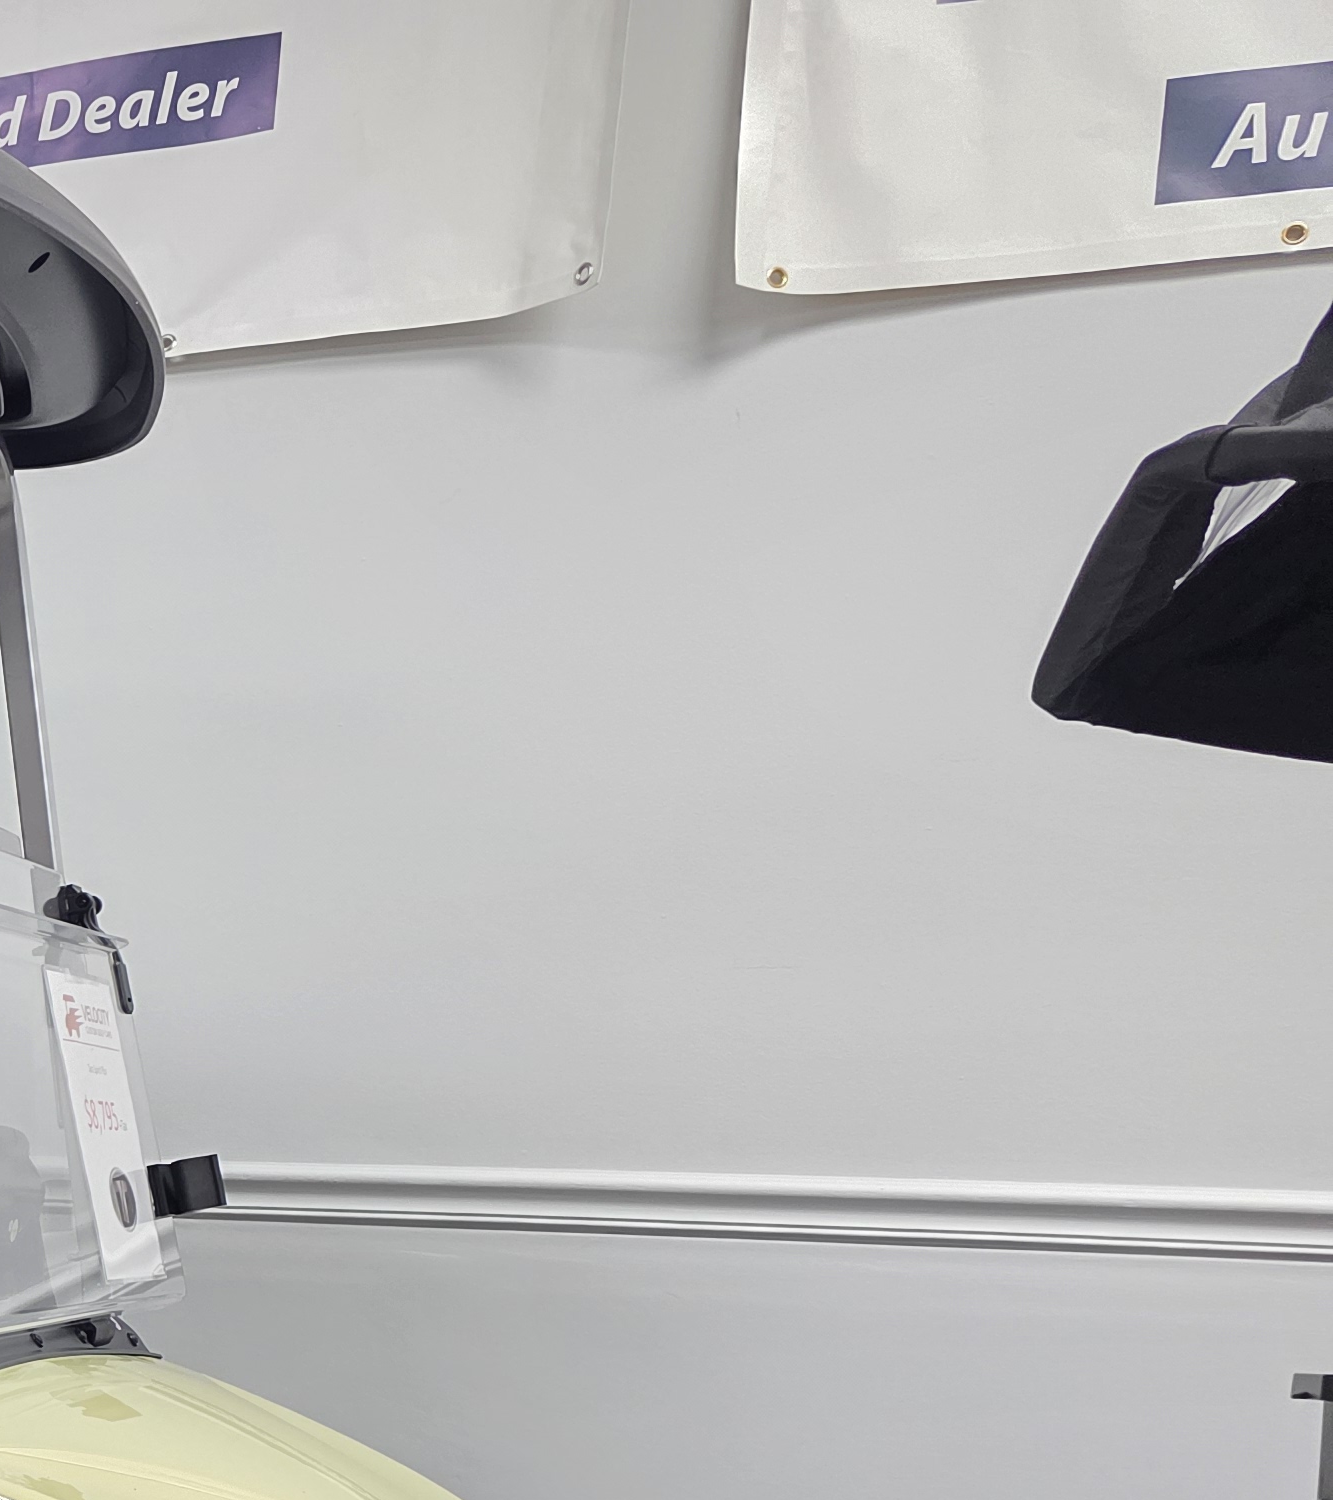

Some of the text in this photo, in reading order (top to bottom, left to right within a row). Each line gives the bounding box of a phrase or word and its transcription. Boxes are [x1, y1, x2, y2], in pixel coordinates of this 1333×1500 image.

[38, 70, 239, 142] Dealer
[1210, 102, 1329, 169] Au
[84, 1094, 119, 1136] $8,795
